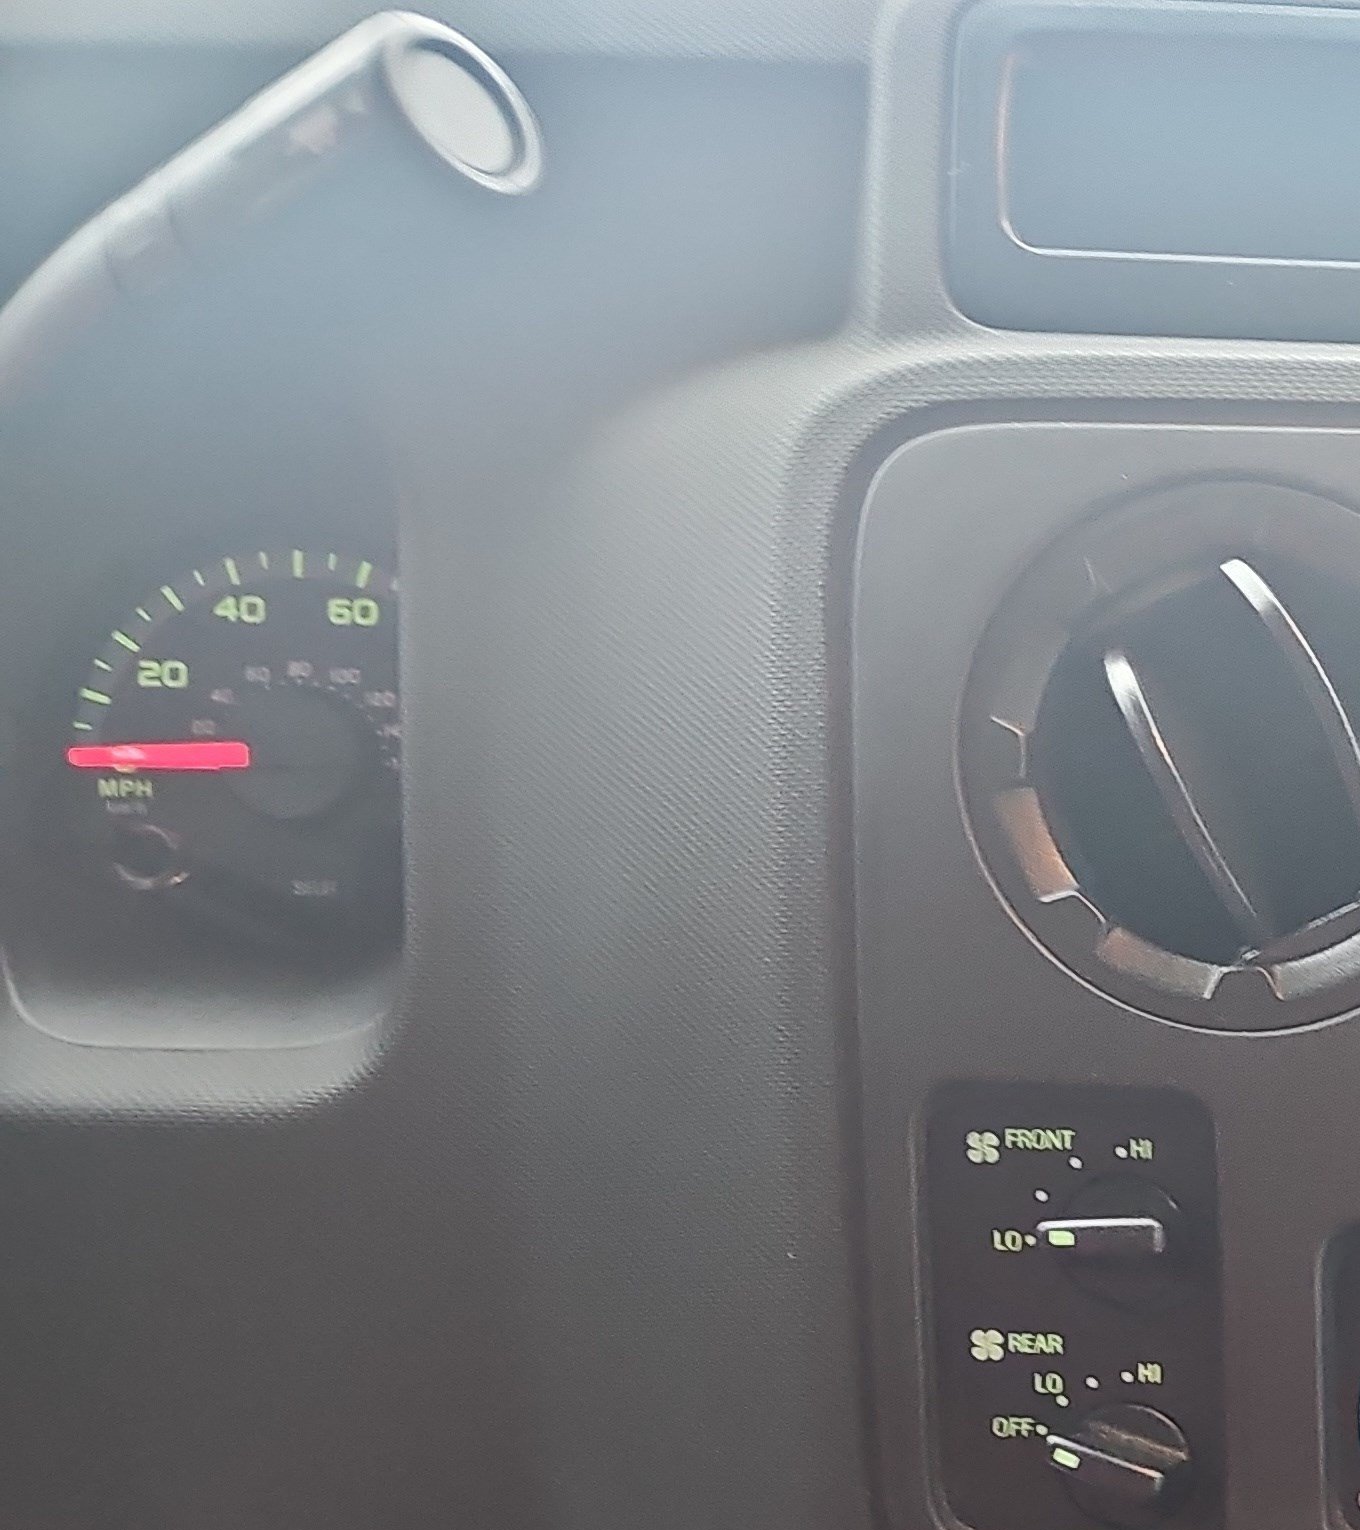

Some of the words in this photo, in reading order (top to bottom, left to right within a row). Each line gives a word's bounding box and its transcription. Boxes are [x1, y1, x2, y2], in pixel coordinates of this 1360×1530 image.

[213, 596, 267, 625] 40
[327, 598, 380, 627] 60
[138, 659, 189, 689] 20
[97, 777, 154, 798] MPH
[1004, 1128, 1076, 1152] FRONT
[1128, 1138, 1154, 1161] HI
[992, 1229, 1023, 1253] LO
[1007, 1333, 1065, 1356] REAR
[1033, 1373, 1065, 1395] LO
[1137, 1362, 1163, 1385] HI
[991, 1416, 1035, 1438] OFF
